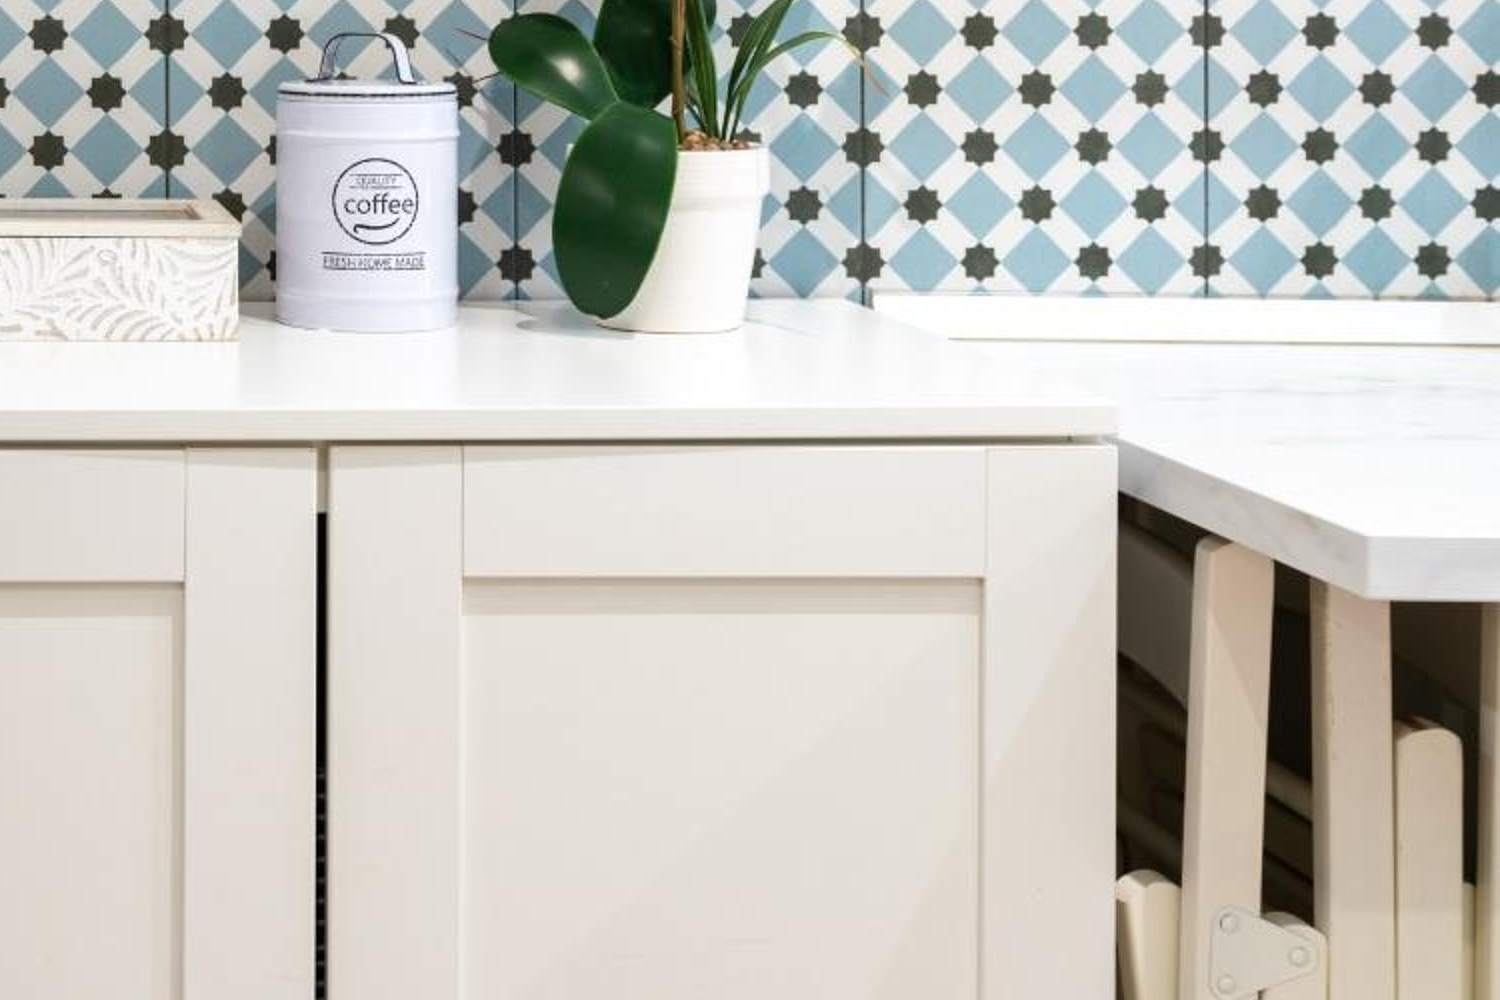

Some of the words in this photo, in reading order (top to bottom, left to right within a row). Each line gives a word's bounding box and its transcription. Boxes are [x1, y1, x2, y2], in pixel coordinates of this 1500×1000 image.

[355, 177, 397, 185] QUALITY
[343, 192, 414, 215] coffee
[323, 256, 356, 267] FRESH
[358, 257, 393, 267] HOME
[395, 257, 424, 267] MADE
